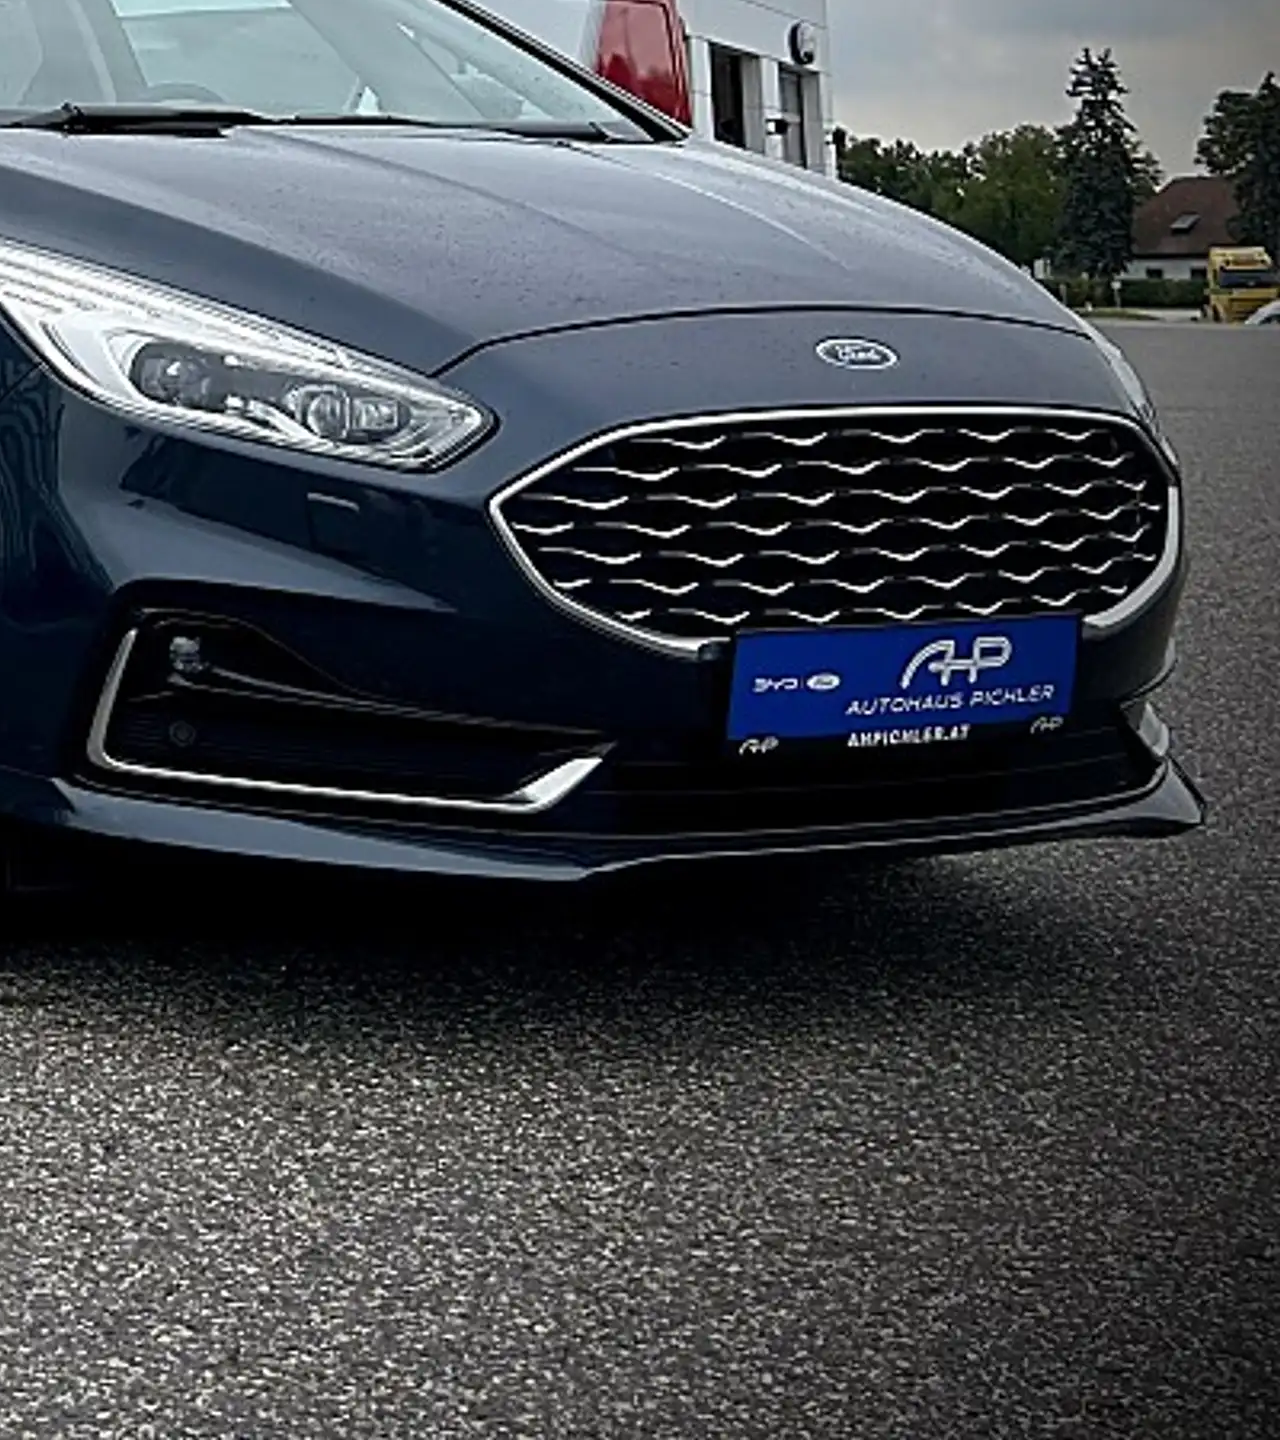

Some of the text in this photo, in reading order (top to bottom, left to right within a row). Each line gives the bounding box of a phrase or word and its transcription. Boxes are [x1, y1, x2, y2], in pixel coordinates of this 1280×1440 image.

[845, 684, 1055, 716] AUTOHAUS PICHLER
[846, 724, 971, 748] AHPICHLER.AT
